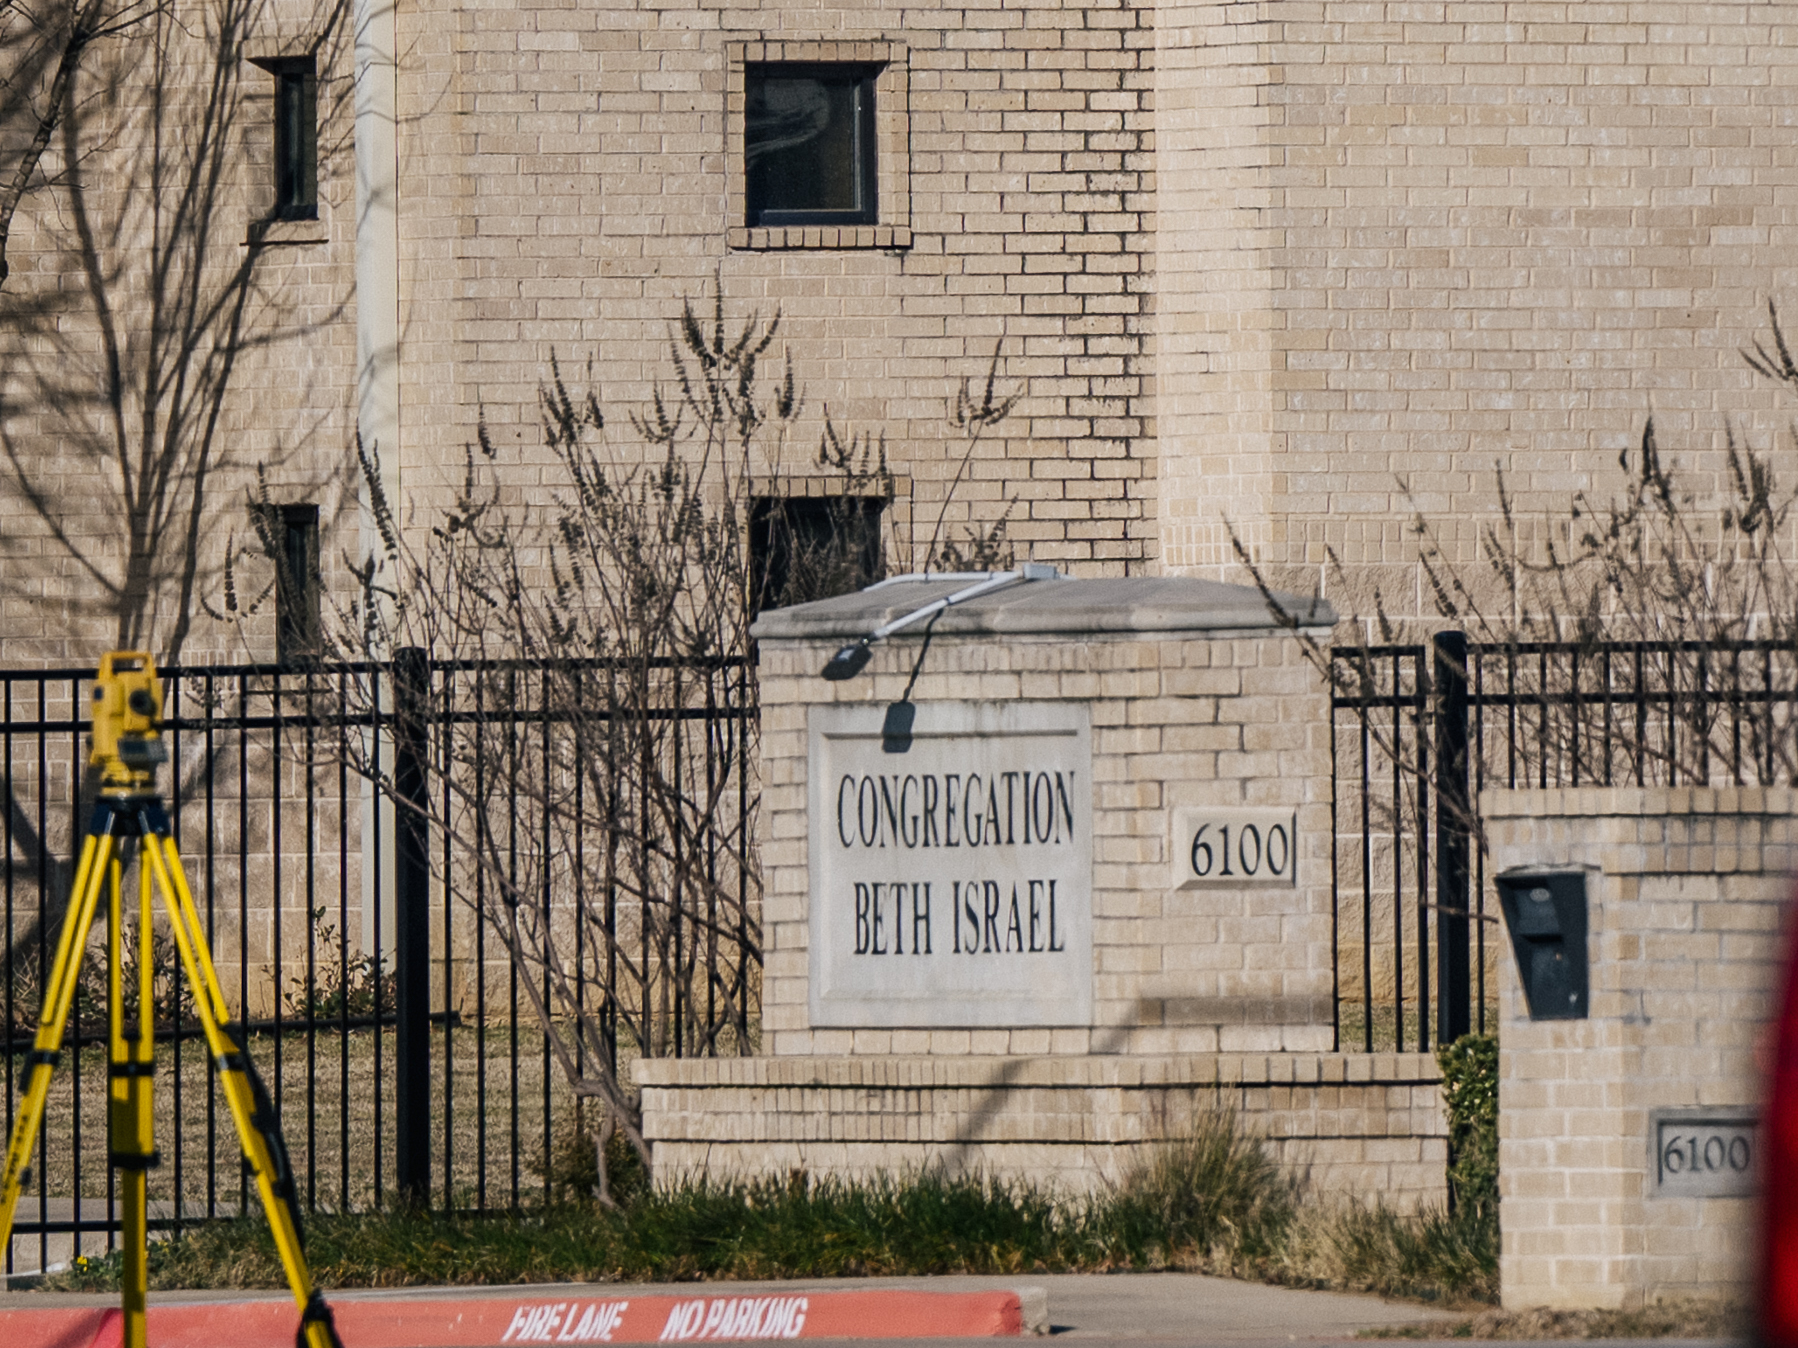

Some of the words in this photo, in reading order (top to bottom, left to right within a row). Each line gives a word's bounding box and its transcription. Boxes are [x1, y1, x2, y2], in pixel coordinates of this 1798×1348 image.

[836, 769, 1076, 849] CONGREGATION
[1190, 822, 1289, 877] 6100
[853, 881, 933, 955] BETH
[952, 879, 1065, 954] ISRAEL
[1663, 1135, 1752, 1174] 6100
[501, 1303, 567, 1342] FIRE
[556, 1301, 629, 1342] LANE
[659, 1299, 705, 1341] NO
[699, 1297, 808, 1340] PARKING
